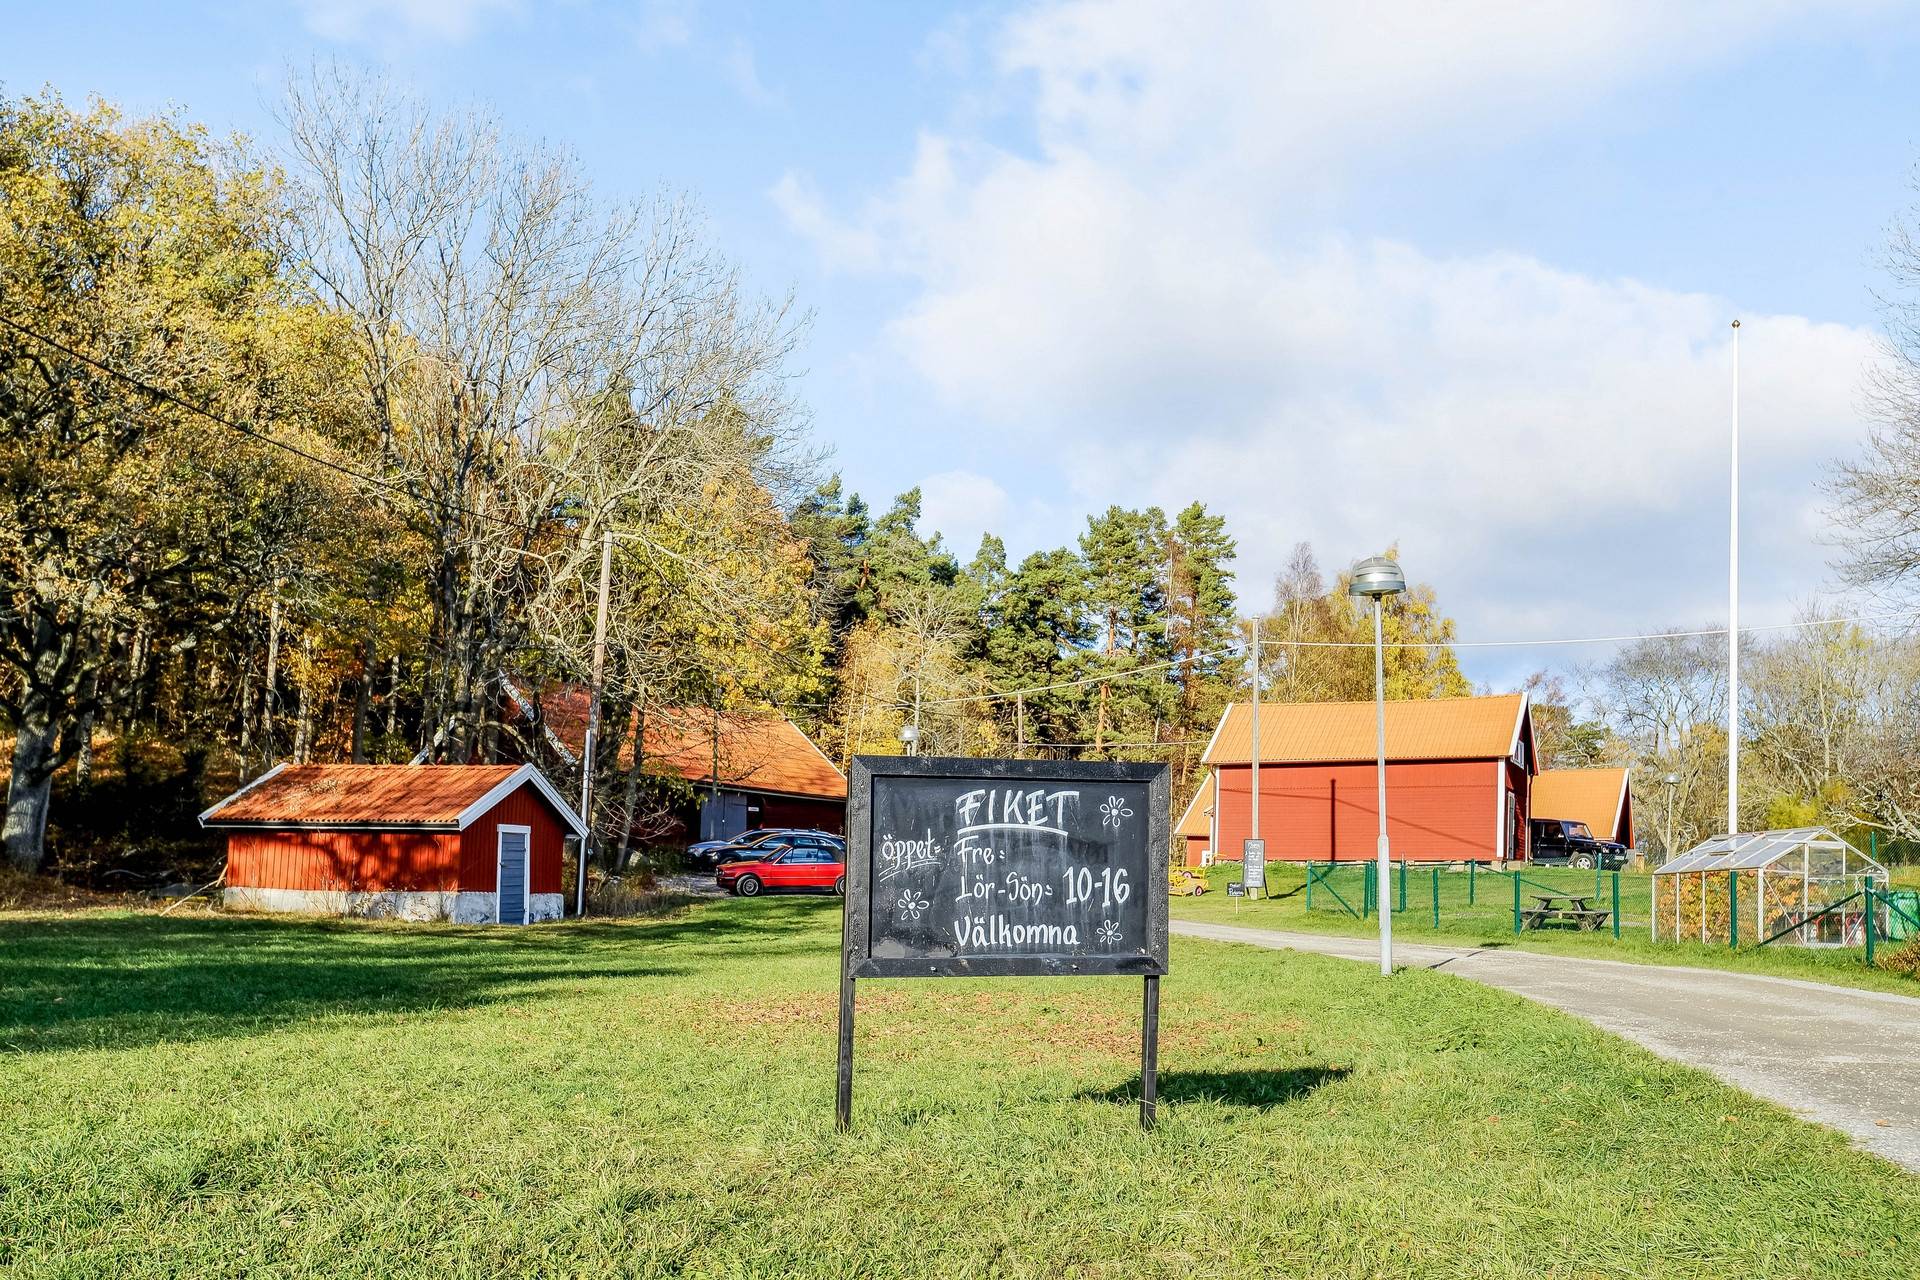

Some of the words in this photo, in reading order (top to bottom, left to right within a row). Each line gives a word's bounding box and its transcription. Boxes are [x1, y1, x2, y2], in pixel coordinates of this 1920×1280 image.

[956, 789, 1080, 827] FIKET
[1062, 866, 1131, 908] 10-16
[953, 914, 1081, 947] Välkomna
